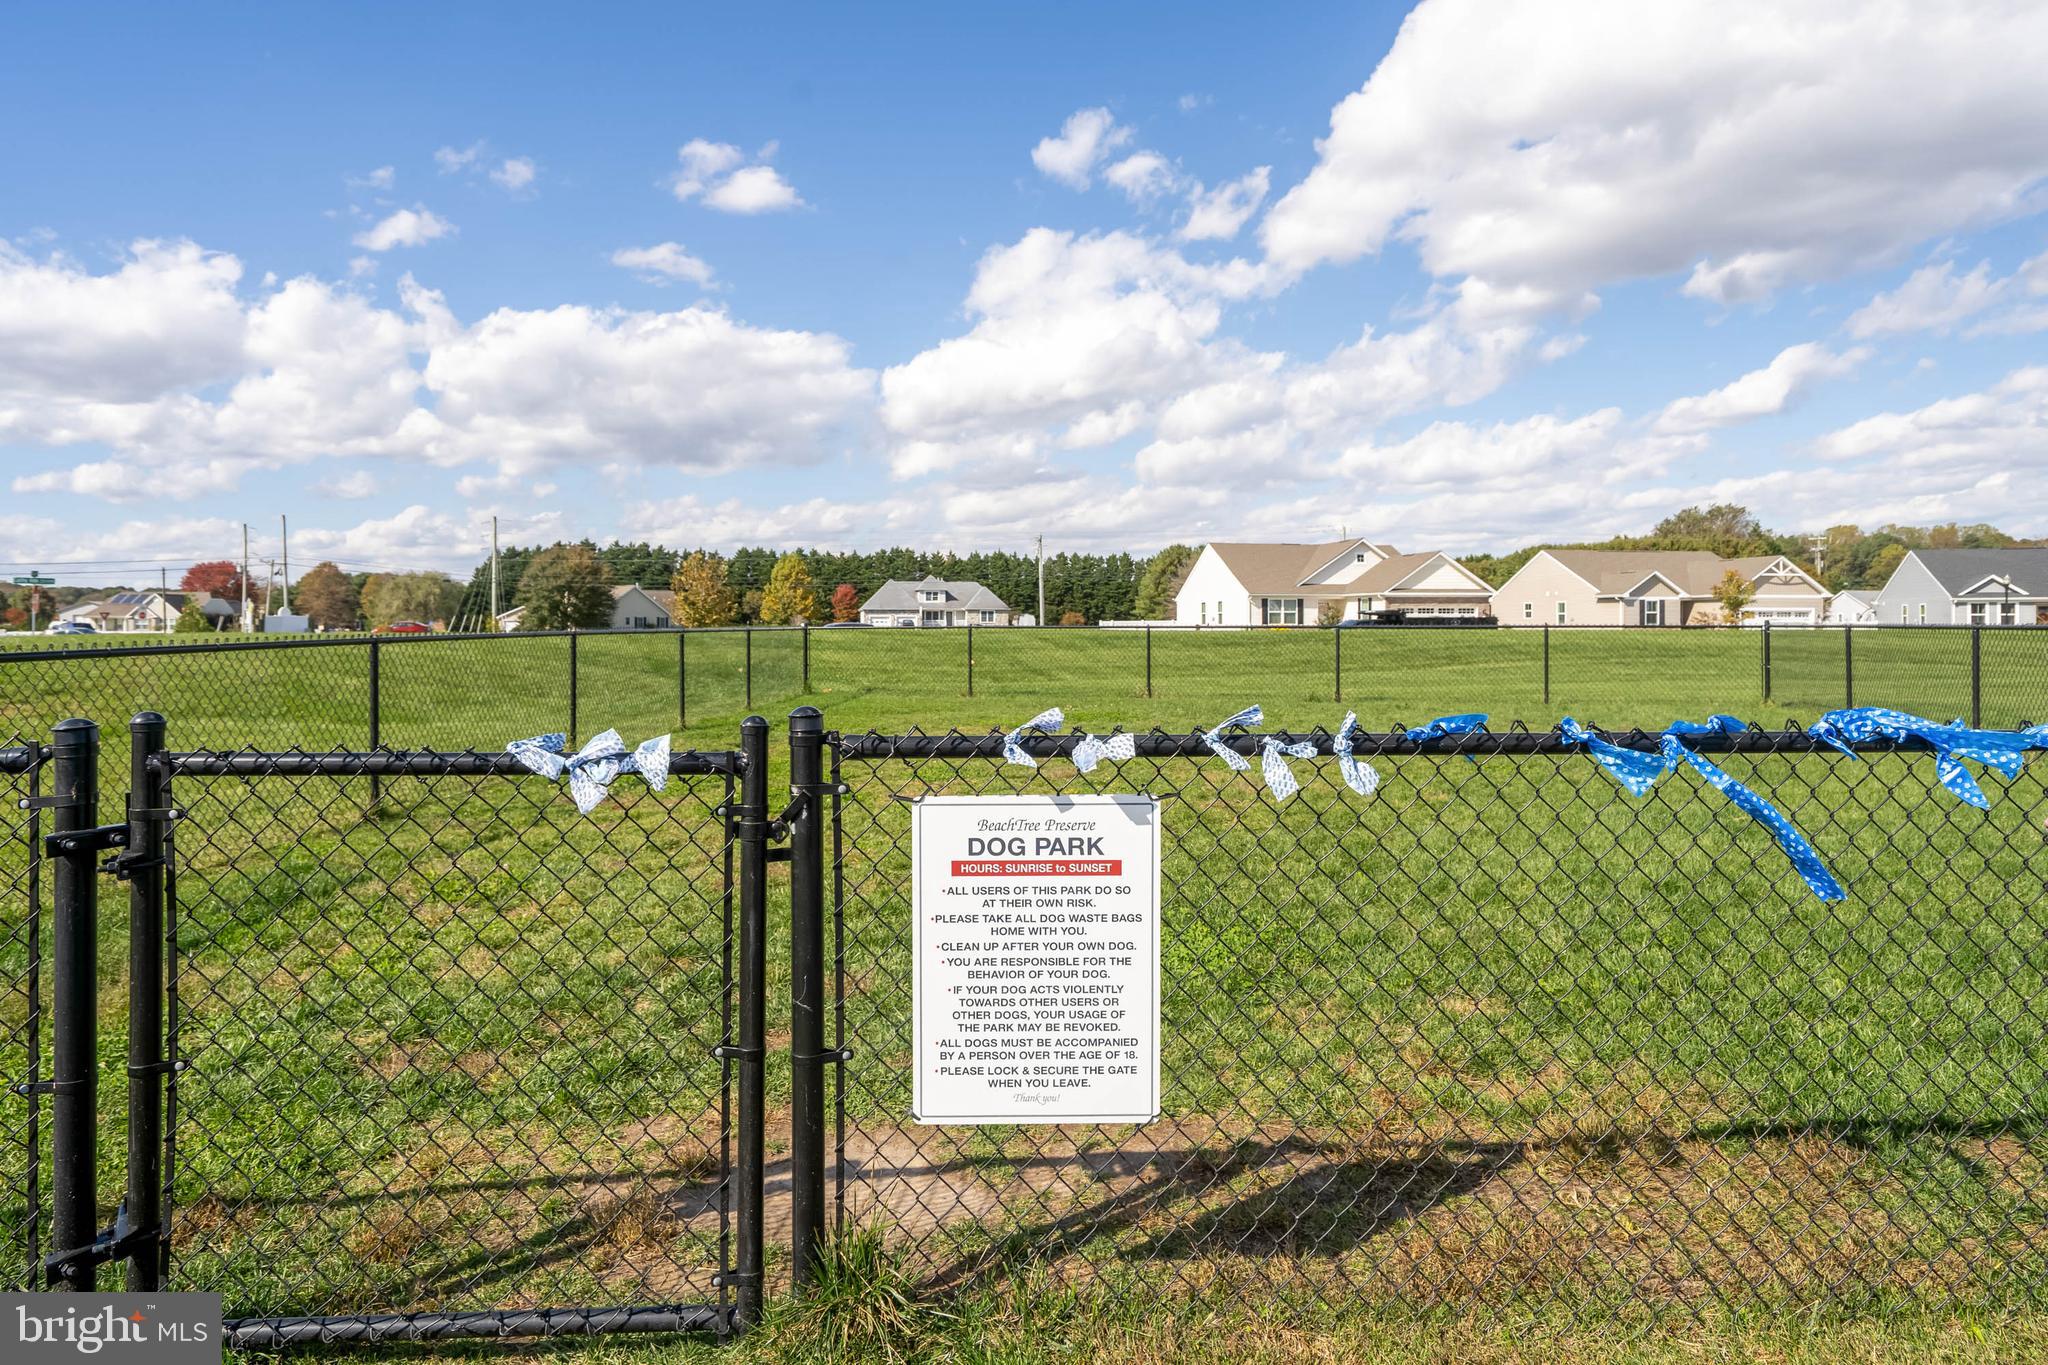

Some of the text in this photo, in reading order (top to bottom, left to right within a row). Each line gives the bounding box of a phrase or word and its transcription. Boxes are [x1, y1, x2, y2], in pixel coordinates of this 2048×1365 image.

[977, 817, 1096, 831] BeachTree Preserve
[968, 837, 1105, 856] DOG PARK
[961, 863, 1112, 873] HOURS: SUNRISE to SUNSET
[947, 885, 1131, 896] ALL USERS OF THIS PARK DO SO
[982, 898, 1096, 908] AT THEIR OWN RISK.
[935, 913, 1143, 924] PLEASE TAKE ALL DOG WASTE BAGS
[990, 926, 1087, 936] HOME WITH YOU.
[941, 941, 1137, 952] CLEAN UP AFTER YOUR OWN DOG.
[946, 957, 1132, 967] YOU ARE RESPONSIBLE FOR THE
[967, 969, 1110, 979] BEHAVIOR OF YOUR DOG.
[953, 985, 1124, 995] IF YOUR DOG ACTS VIOLENTLY
[958, 997, 1119, 1007] TOWARDS OTHER USERS OR
[952, 1010, 1126, 1021] OTHER DOGS, YOUR USAGE OF
[957, 1022, 1121, 1032] THE PARK MAY BE REVOKED.
[940, 1038, 1139, 1048] ALL DOGS MUST BE ACCOMPANIED
[940, 1050, 1138, 1061] BY A PERSON OVER THE AGE OF 18.
[940, 1065, 1138, 1076] PLEASE LOCK & SECURE THE GATE
[987, 1078, 1091, 1088] WHEN YOU LEAVE.
[1013, 1093, 1060, 1106] Thank you!
